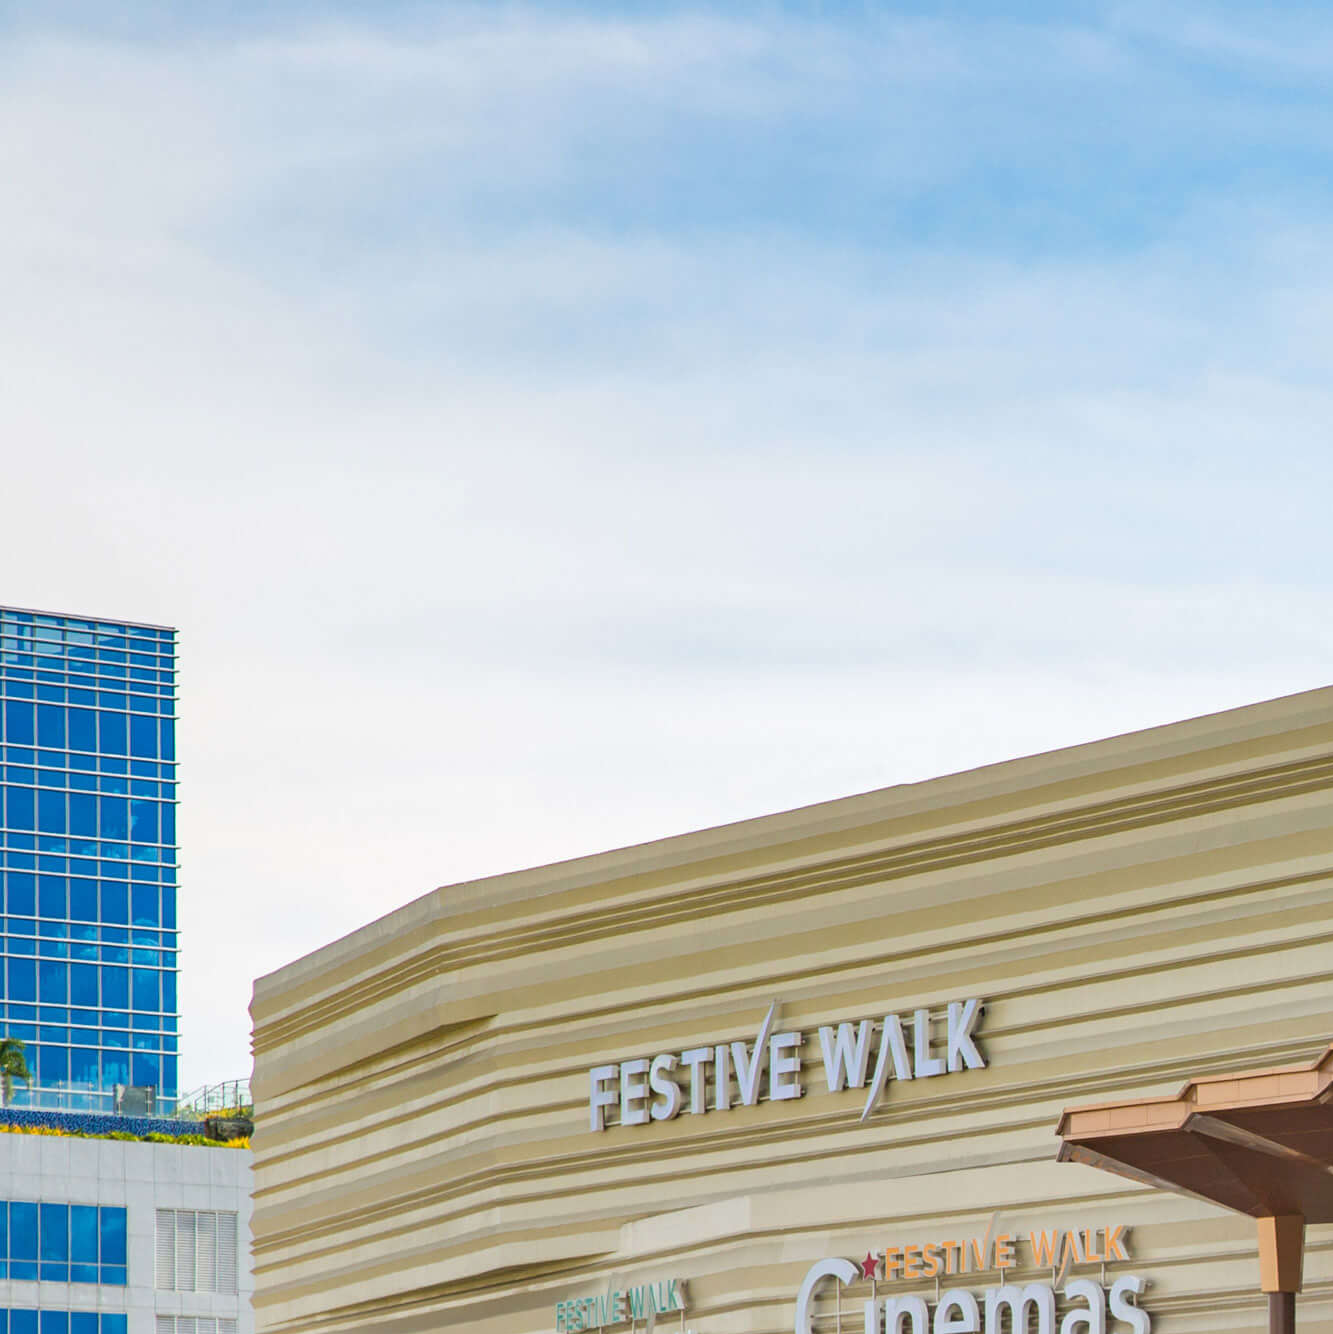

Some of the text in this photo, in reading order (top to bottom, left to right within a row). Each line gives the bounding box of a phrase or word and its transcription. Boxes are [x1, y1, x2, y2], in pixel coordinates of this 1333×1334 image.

[589, 999, 987, 1131] FESTIVE WALK
[885, 1212, 1131, 1288] FESTIVE WALK
[556, 1279, 688, 1332] FESTIVE WALK
